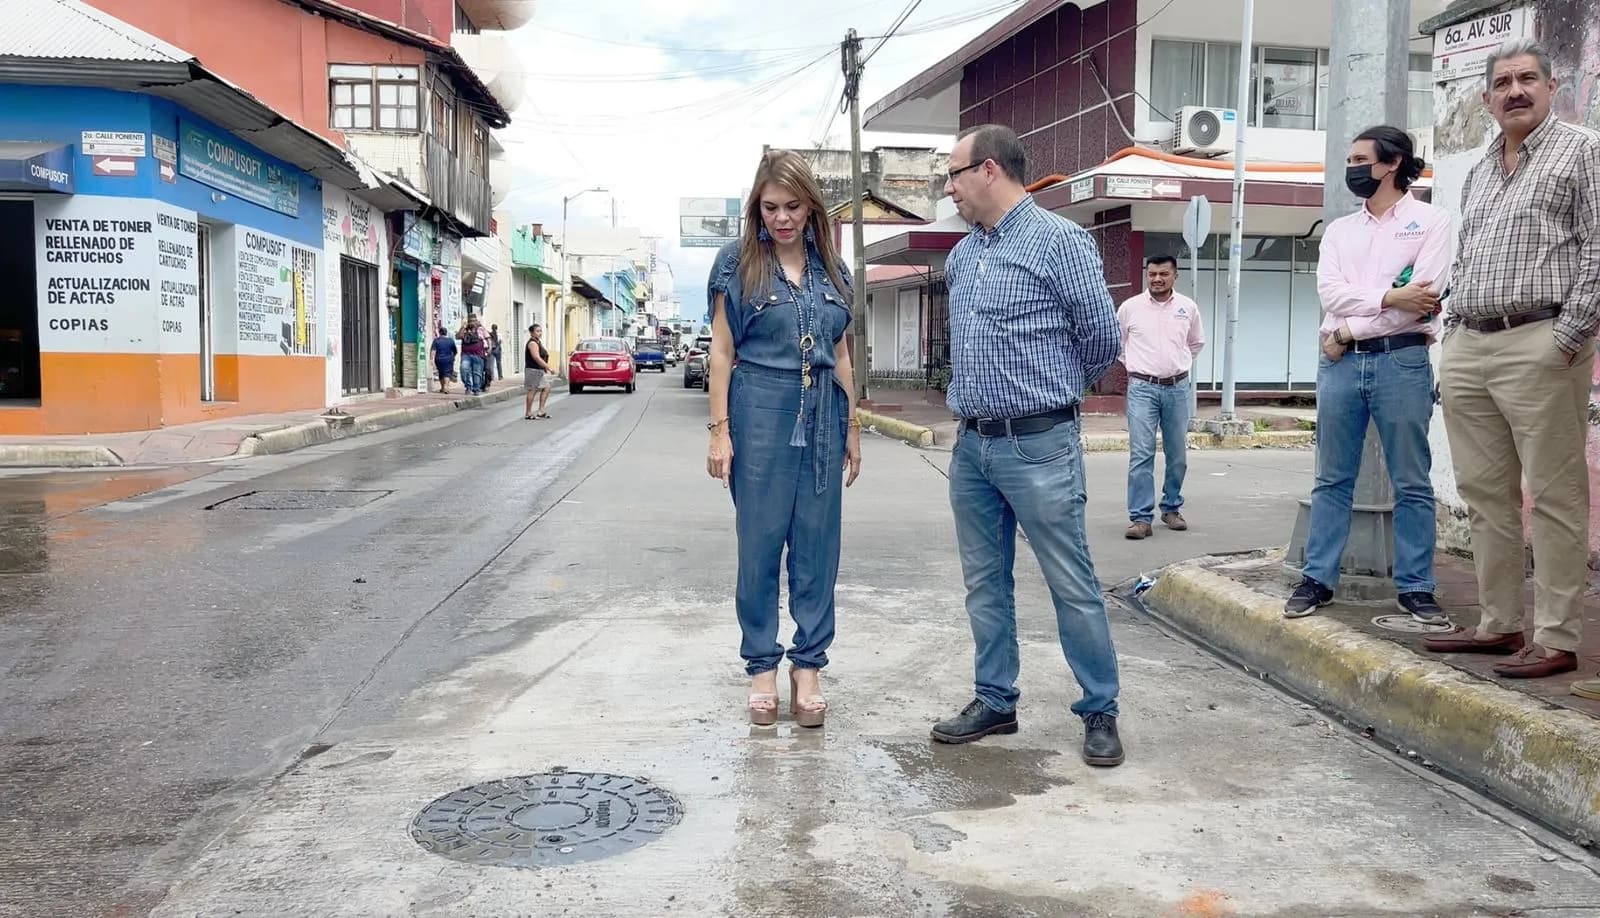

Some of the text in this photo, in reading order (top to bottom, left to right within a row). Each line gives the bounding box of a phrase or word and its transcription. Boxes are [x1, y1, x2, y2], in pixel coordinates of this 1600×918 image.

[1445, 14, 1512, 44] 6a. AV. SUR
[207, 139, 262, 180] COMPUSOFT
[30, 164, 68, 184] COMPUSOFT
[46, 219, 152, 233] VENTA DE TONER
[157, 213, 196, 233] VENTA DE TONER
[46, 236, 135, 250] RELLENADO DE
[158, 239, 185, 257] RELLENADO
[246, 232, 286, 258] COMPUSOFT
[46, 252, 123, 264] CARTUCHOS
[158, 254, 186, 270] CARTUCHOS
[48, 278, 150, 291] ACTUALIZACION
[48, 291, 115, 304] DE ACTAS
[169, 296, 185, 308] ACTAS
[50, 319, 108, 331] COPIAS
[162, 320, 182, 333] COPIAS
